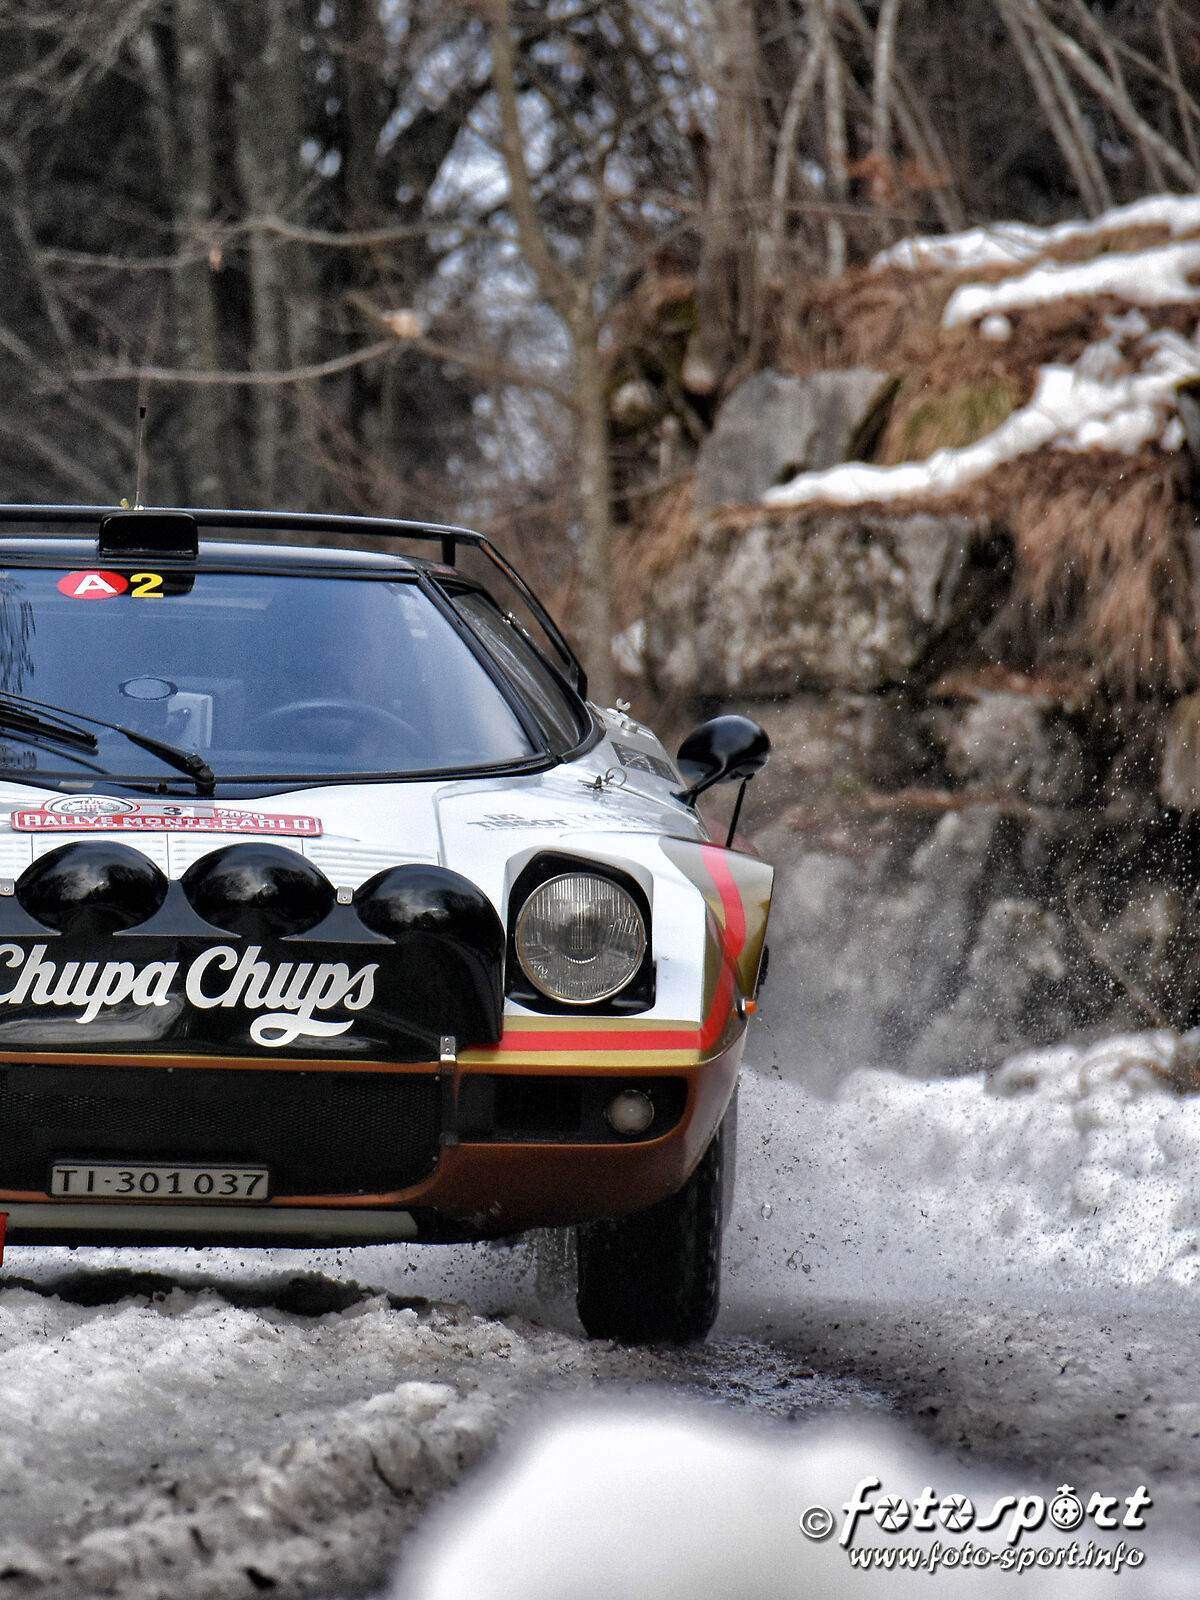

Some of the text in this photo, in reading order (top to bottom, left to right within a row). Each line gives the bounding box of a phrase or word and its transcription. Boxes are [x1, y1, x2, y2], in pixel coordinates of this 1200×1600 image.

[73, 573, 164, 598] A 2
[23, 814, 114, 827] RALLYE
[122, 816, 312, 830] MONTE-CARLO
[163, 806, 265, 820] 3 2020
[185, 945, 380, 1048] Chups
[194, 1173, 264, 1196] 037
